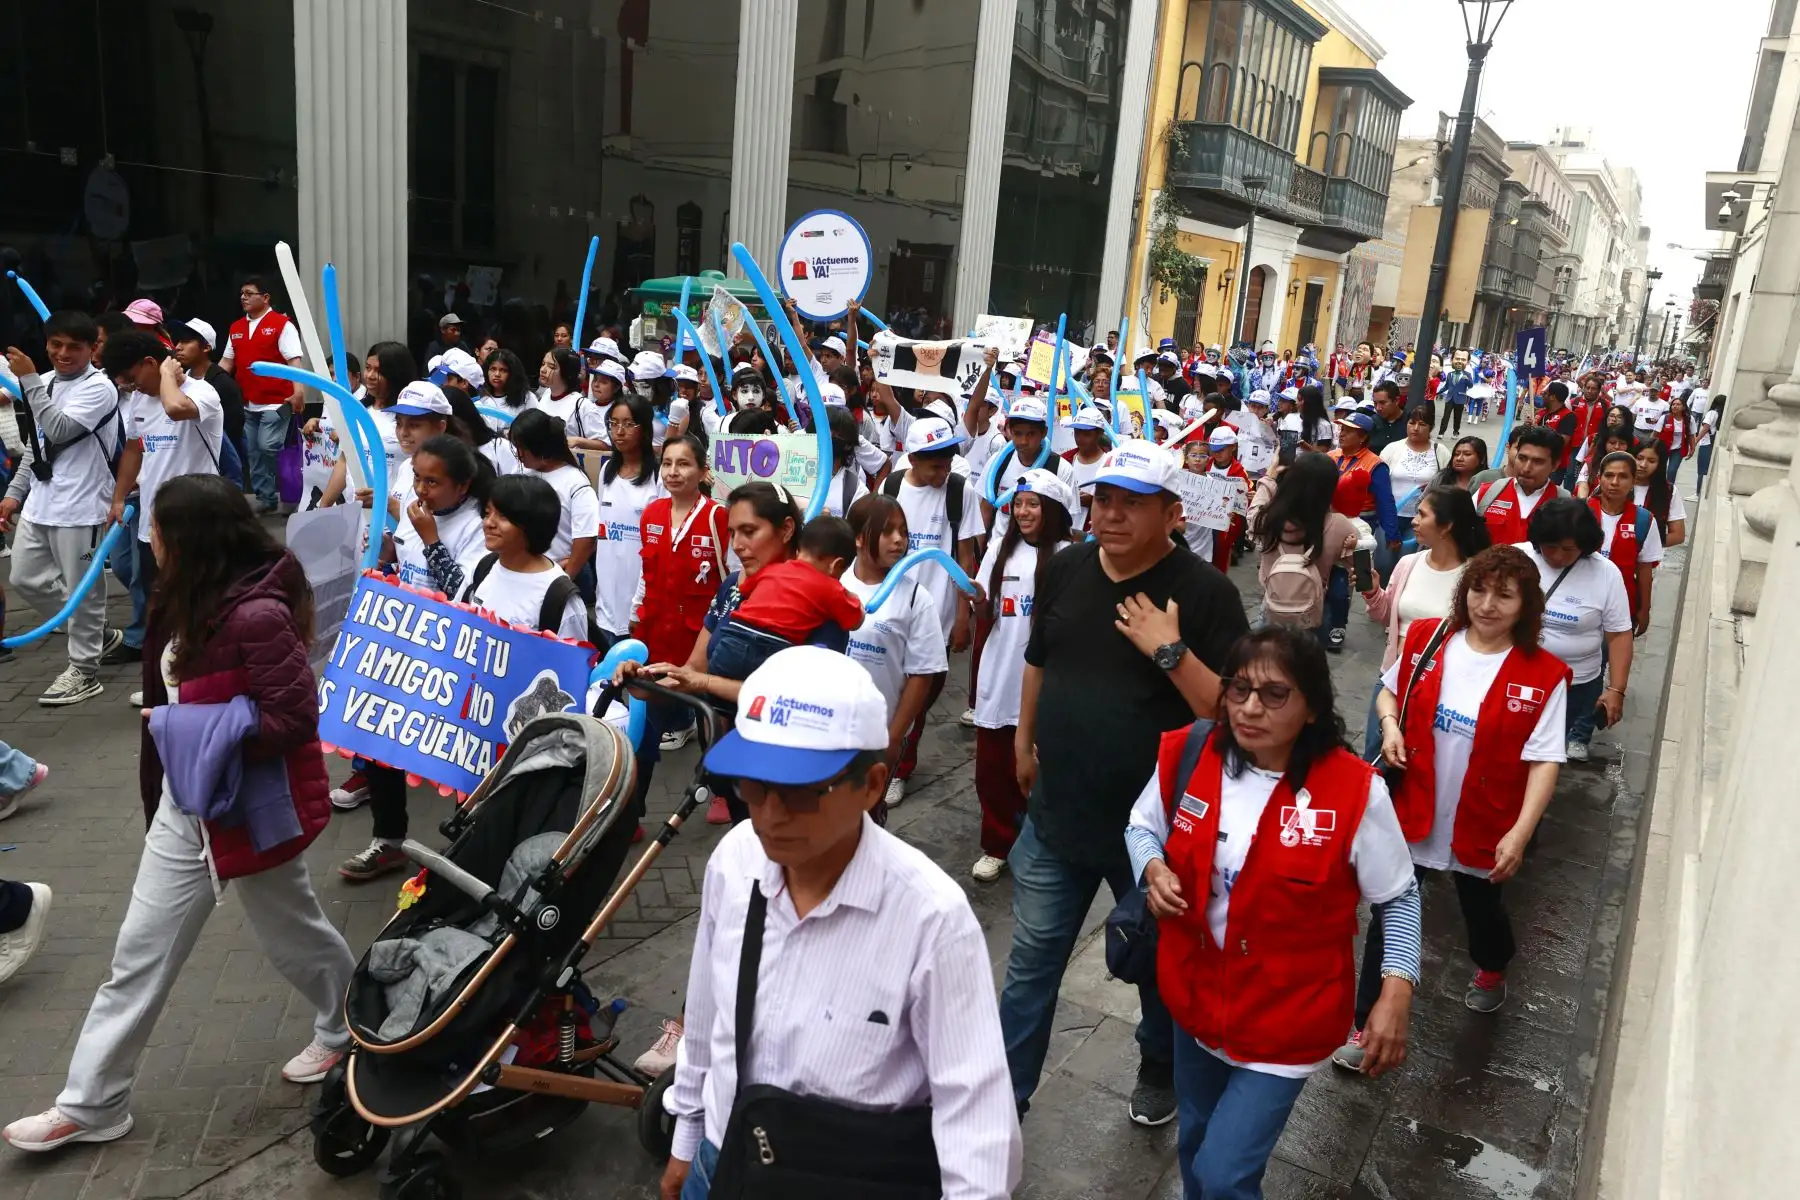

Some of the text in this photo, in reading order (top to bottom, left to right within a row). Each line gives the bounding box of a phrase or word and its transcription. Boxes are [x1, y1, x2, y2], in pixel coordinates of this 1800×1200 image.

[812, 257, 859, 265] ¡Actuemos
[812, 265, 830, 278] YA!
[1524, 337, 1536, 368] 4
[714, 439, 780, 478] ALTO
[608, 521, 640, 533] ¡Actuem
[608, 529, 623, 541] YA!
[402, 561, 430, 576] Actuem
[353, 590, 452, 651] AISLES
[453, 623, 482, 667] DE
[483, 637, 511, 678] TU
[850, 639, 887, 654] tuemos
[338, 632, 364, 668] Y
[356, 641, 459, 706] AMIGOS
[460, 673, 495, 727] ¡NO
[769, 706, 791, 727] YA!
[1436, 704, 1476, 728] Actuem
